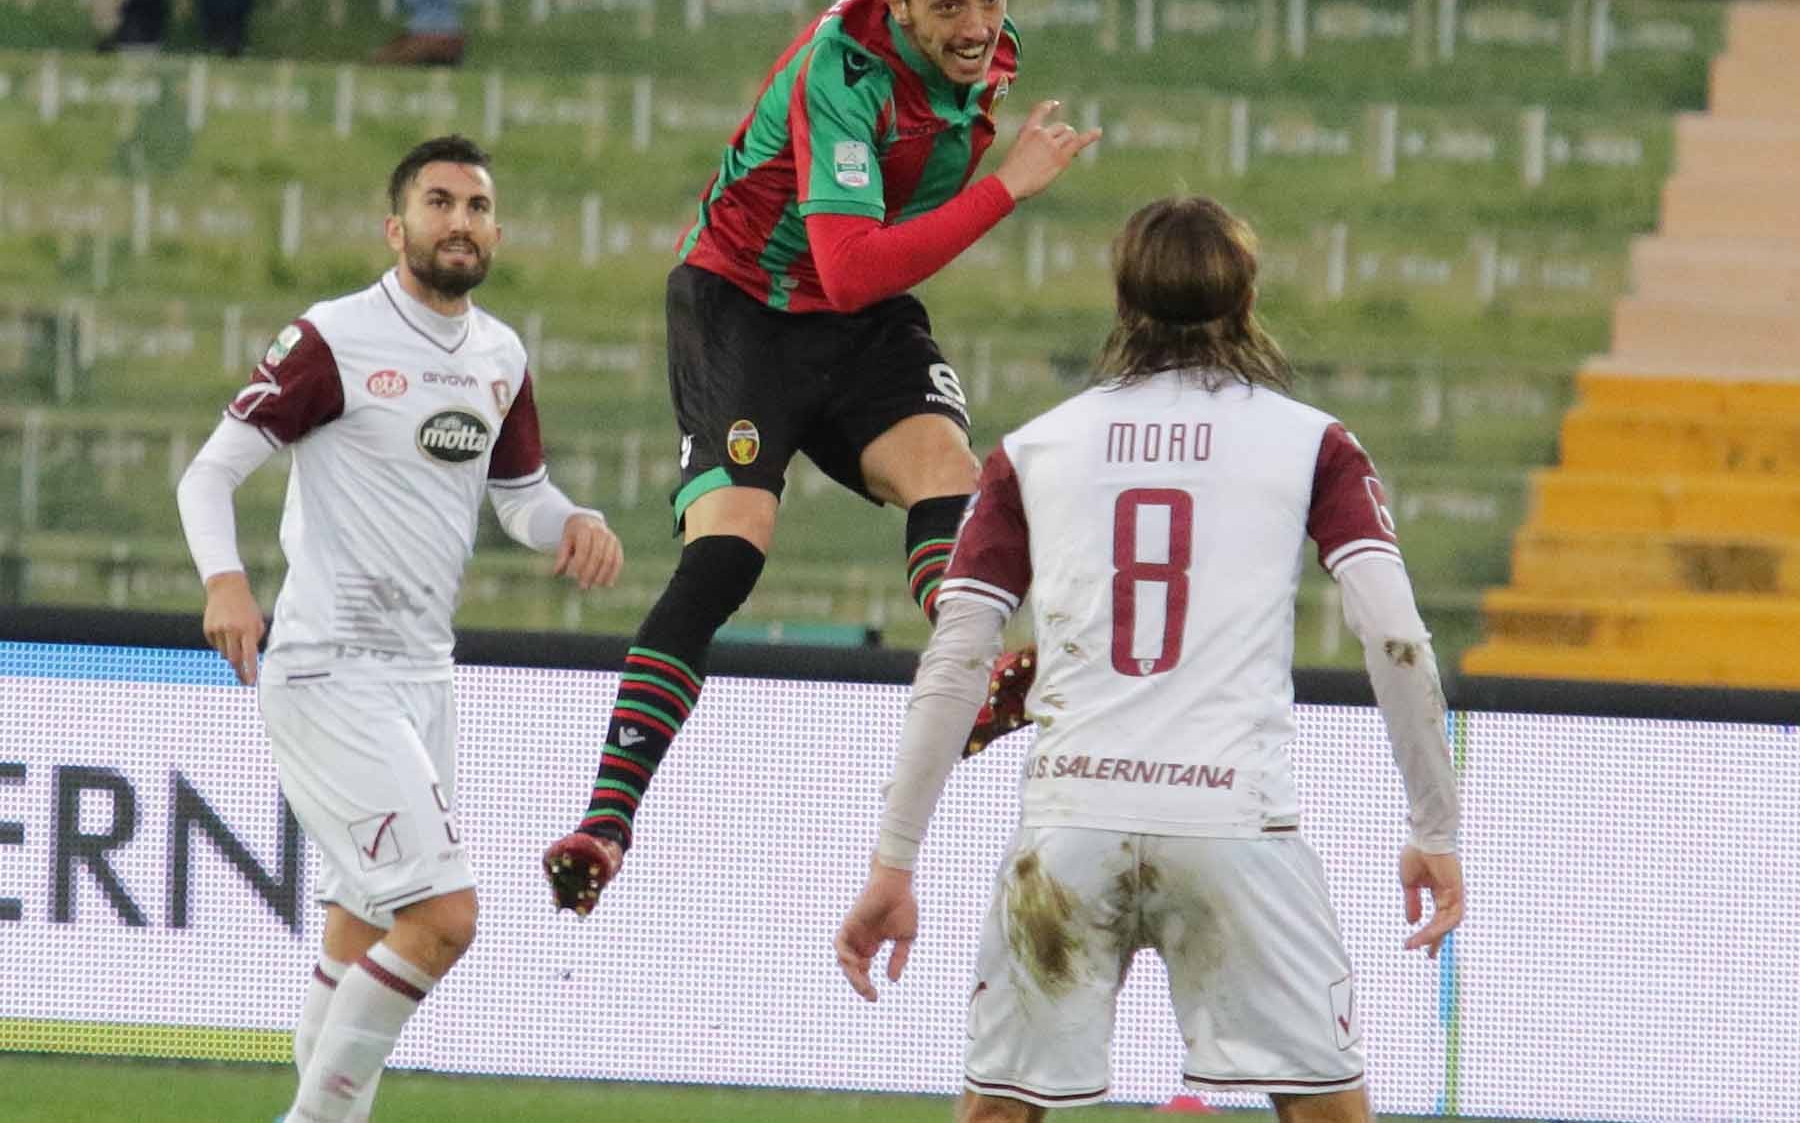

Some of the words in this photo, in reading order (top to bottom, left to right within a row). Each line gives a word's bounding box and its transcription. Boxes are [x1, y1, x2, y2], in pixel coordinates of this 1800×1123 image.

[422, 424, 488, 452] motta
[1106, 422, 1212, 463] MORO
[1110, 487, 1194, 677] 8
[1052, 754, 1236, 790] SALERNITANA
